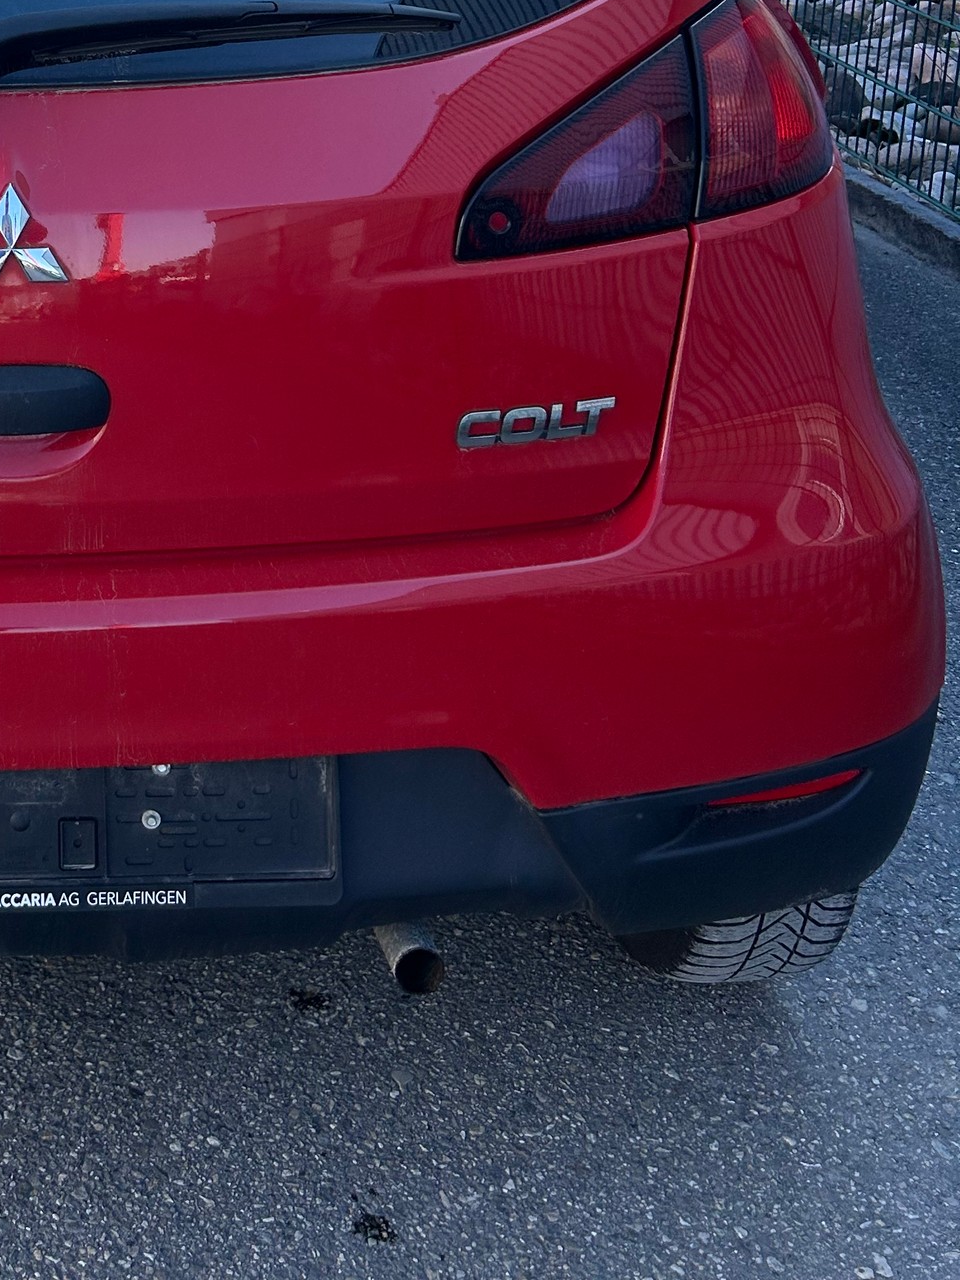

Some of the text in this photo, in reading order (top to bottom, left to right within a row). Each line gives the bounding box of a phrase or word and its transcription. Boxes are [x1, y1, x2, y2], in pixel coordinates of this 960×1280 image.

[456, 396, 616, 449] COLT
[58, 892, 80, 907] AG
[87, 890, 187, 906] GERLAFINGEN
